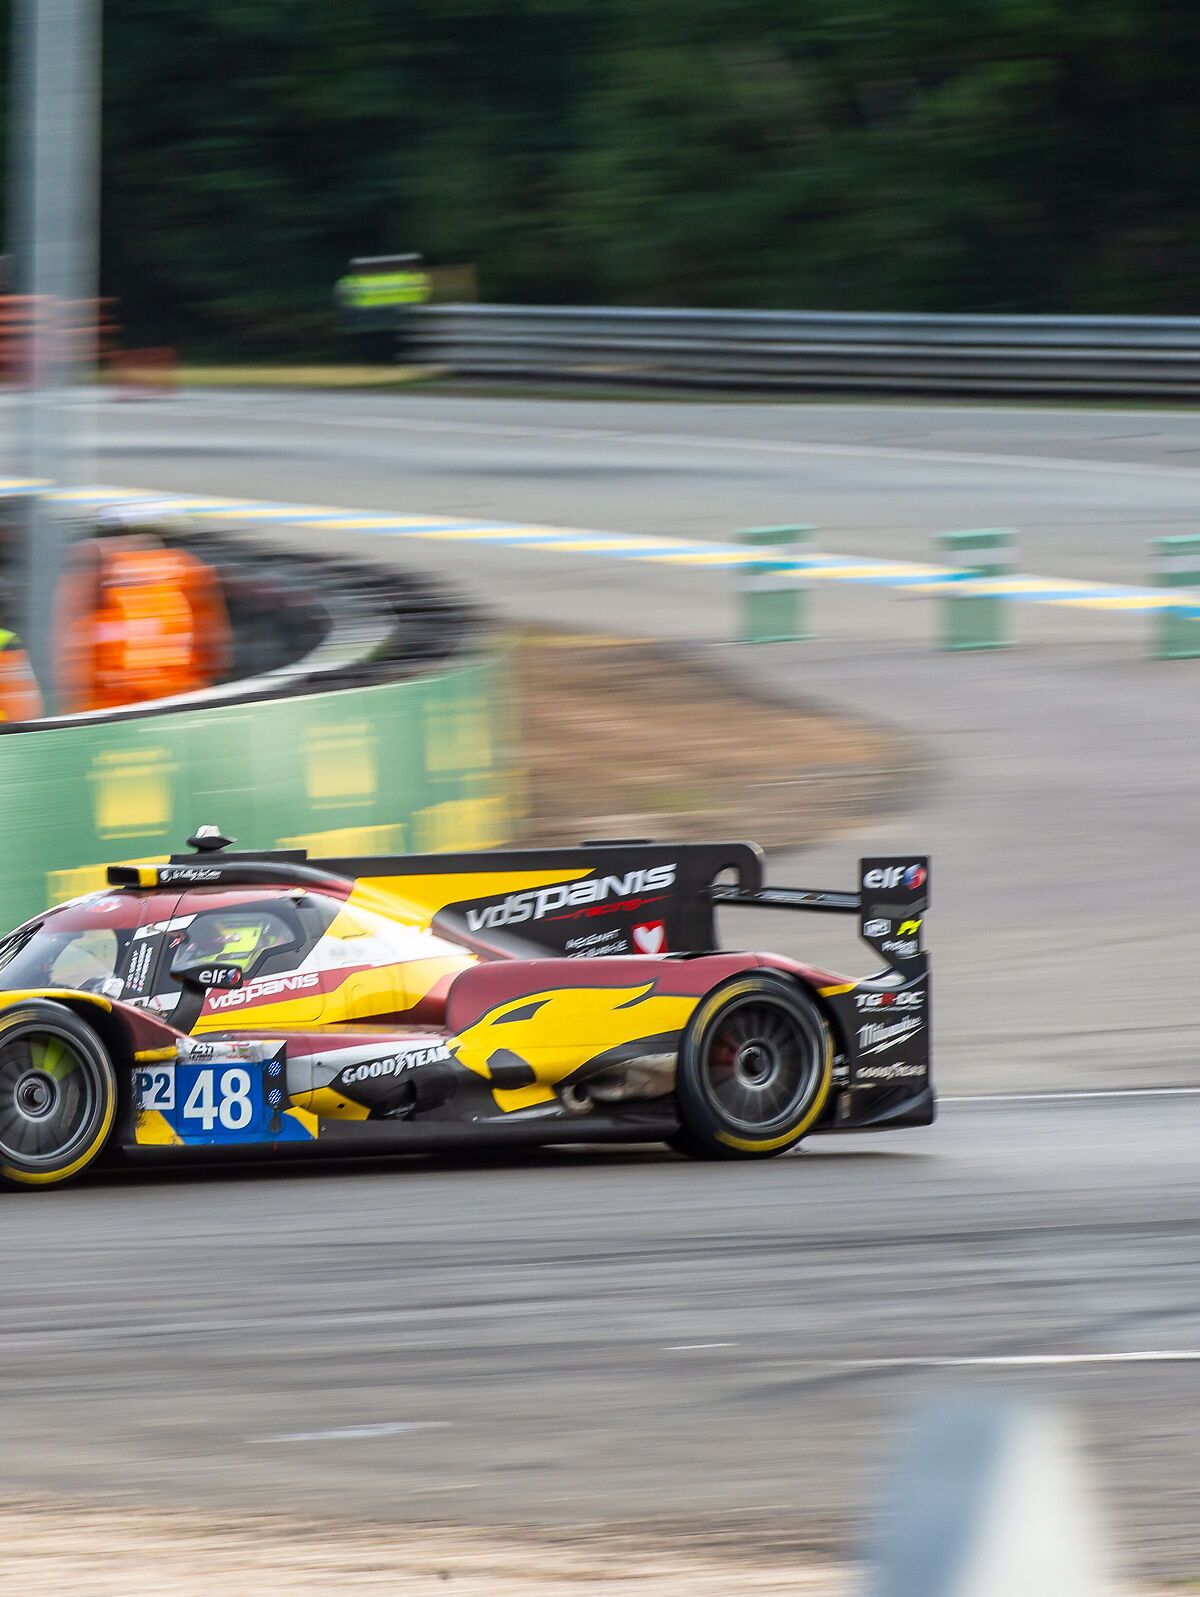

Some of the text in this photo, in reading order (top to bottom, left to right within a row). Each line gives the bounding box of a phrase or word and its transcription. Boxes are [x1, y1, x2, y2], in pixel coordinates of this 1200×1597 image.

[863, 865, 906, 888] elf
[199, 969, 227, 984] elf
[341, 1045, 451, 1085] GOODYEAR
[183, 1068, 253, 1130] 48
